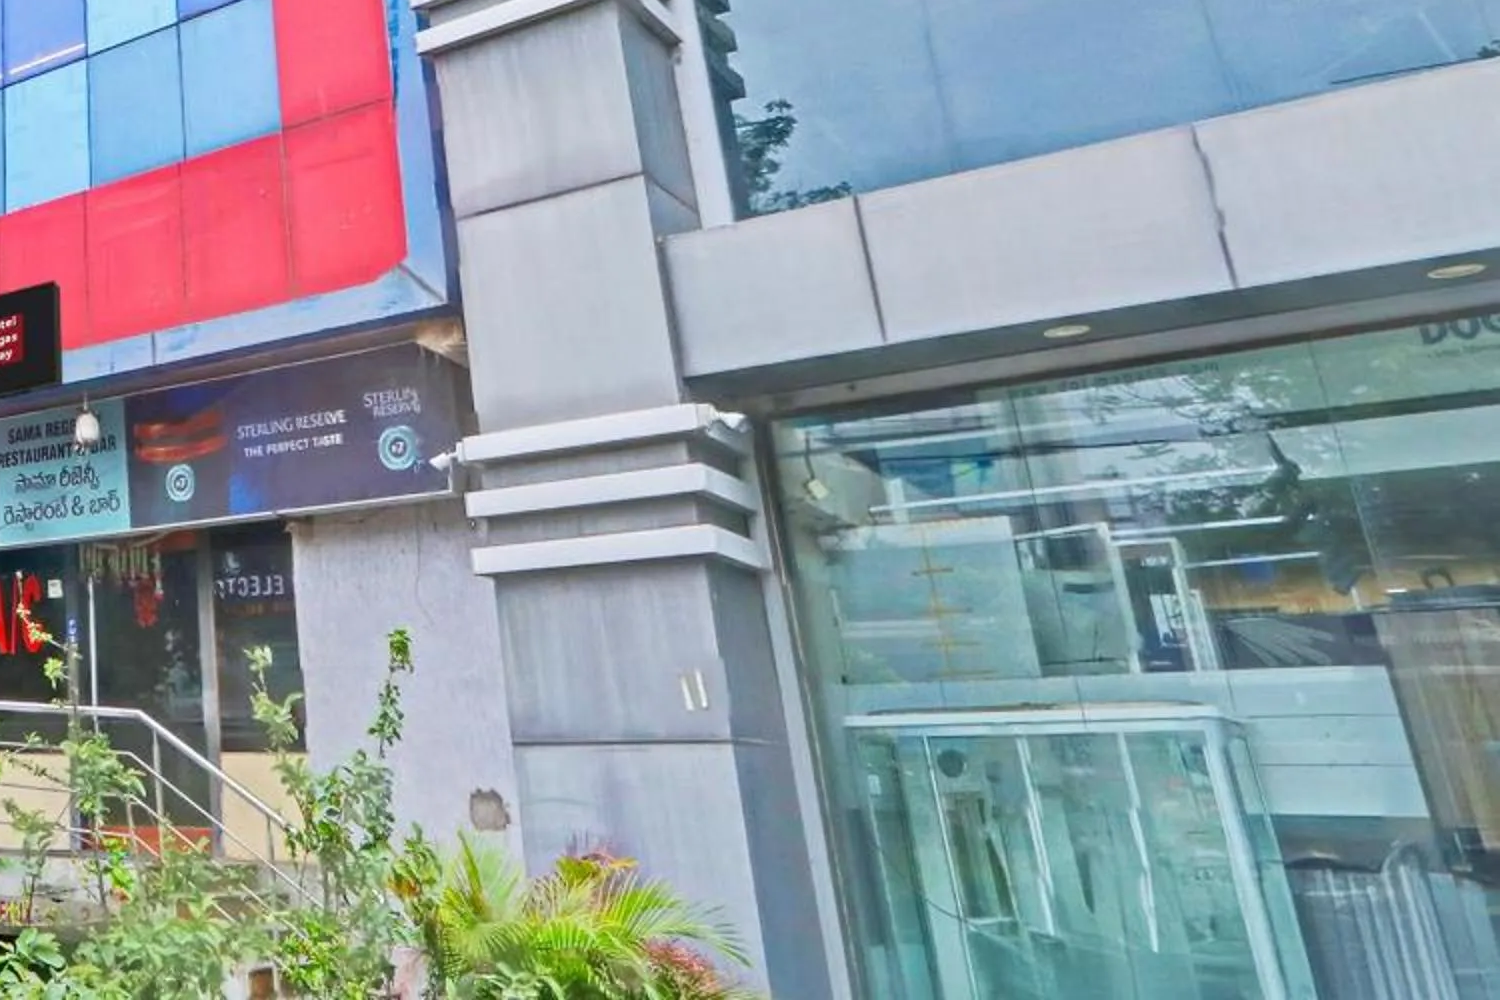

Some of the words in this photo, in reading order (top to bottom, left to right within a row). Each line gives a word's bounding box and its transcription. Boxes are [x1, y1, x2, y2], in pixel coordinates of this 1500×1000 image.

[7, 424, 43, 445] SAMA
[237, 417, 293, 439] STERLING
[295, 409, 347, 429] RESERVE
[243, 445, 264, 457] THE
[266, 438, 309, 455] PERFECT
